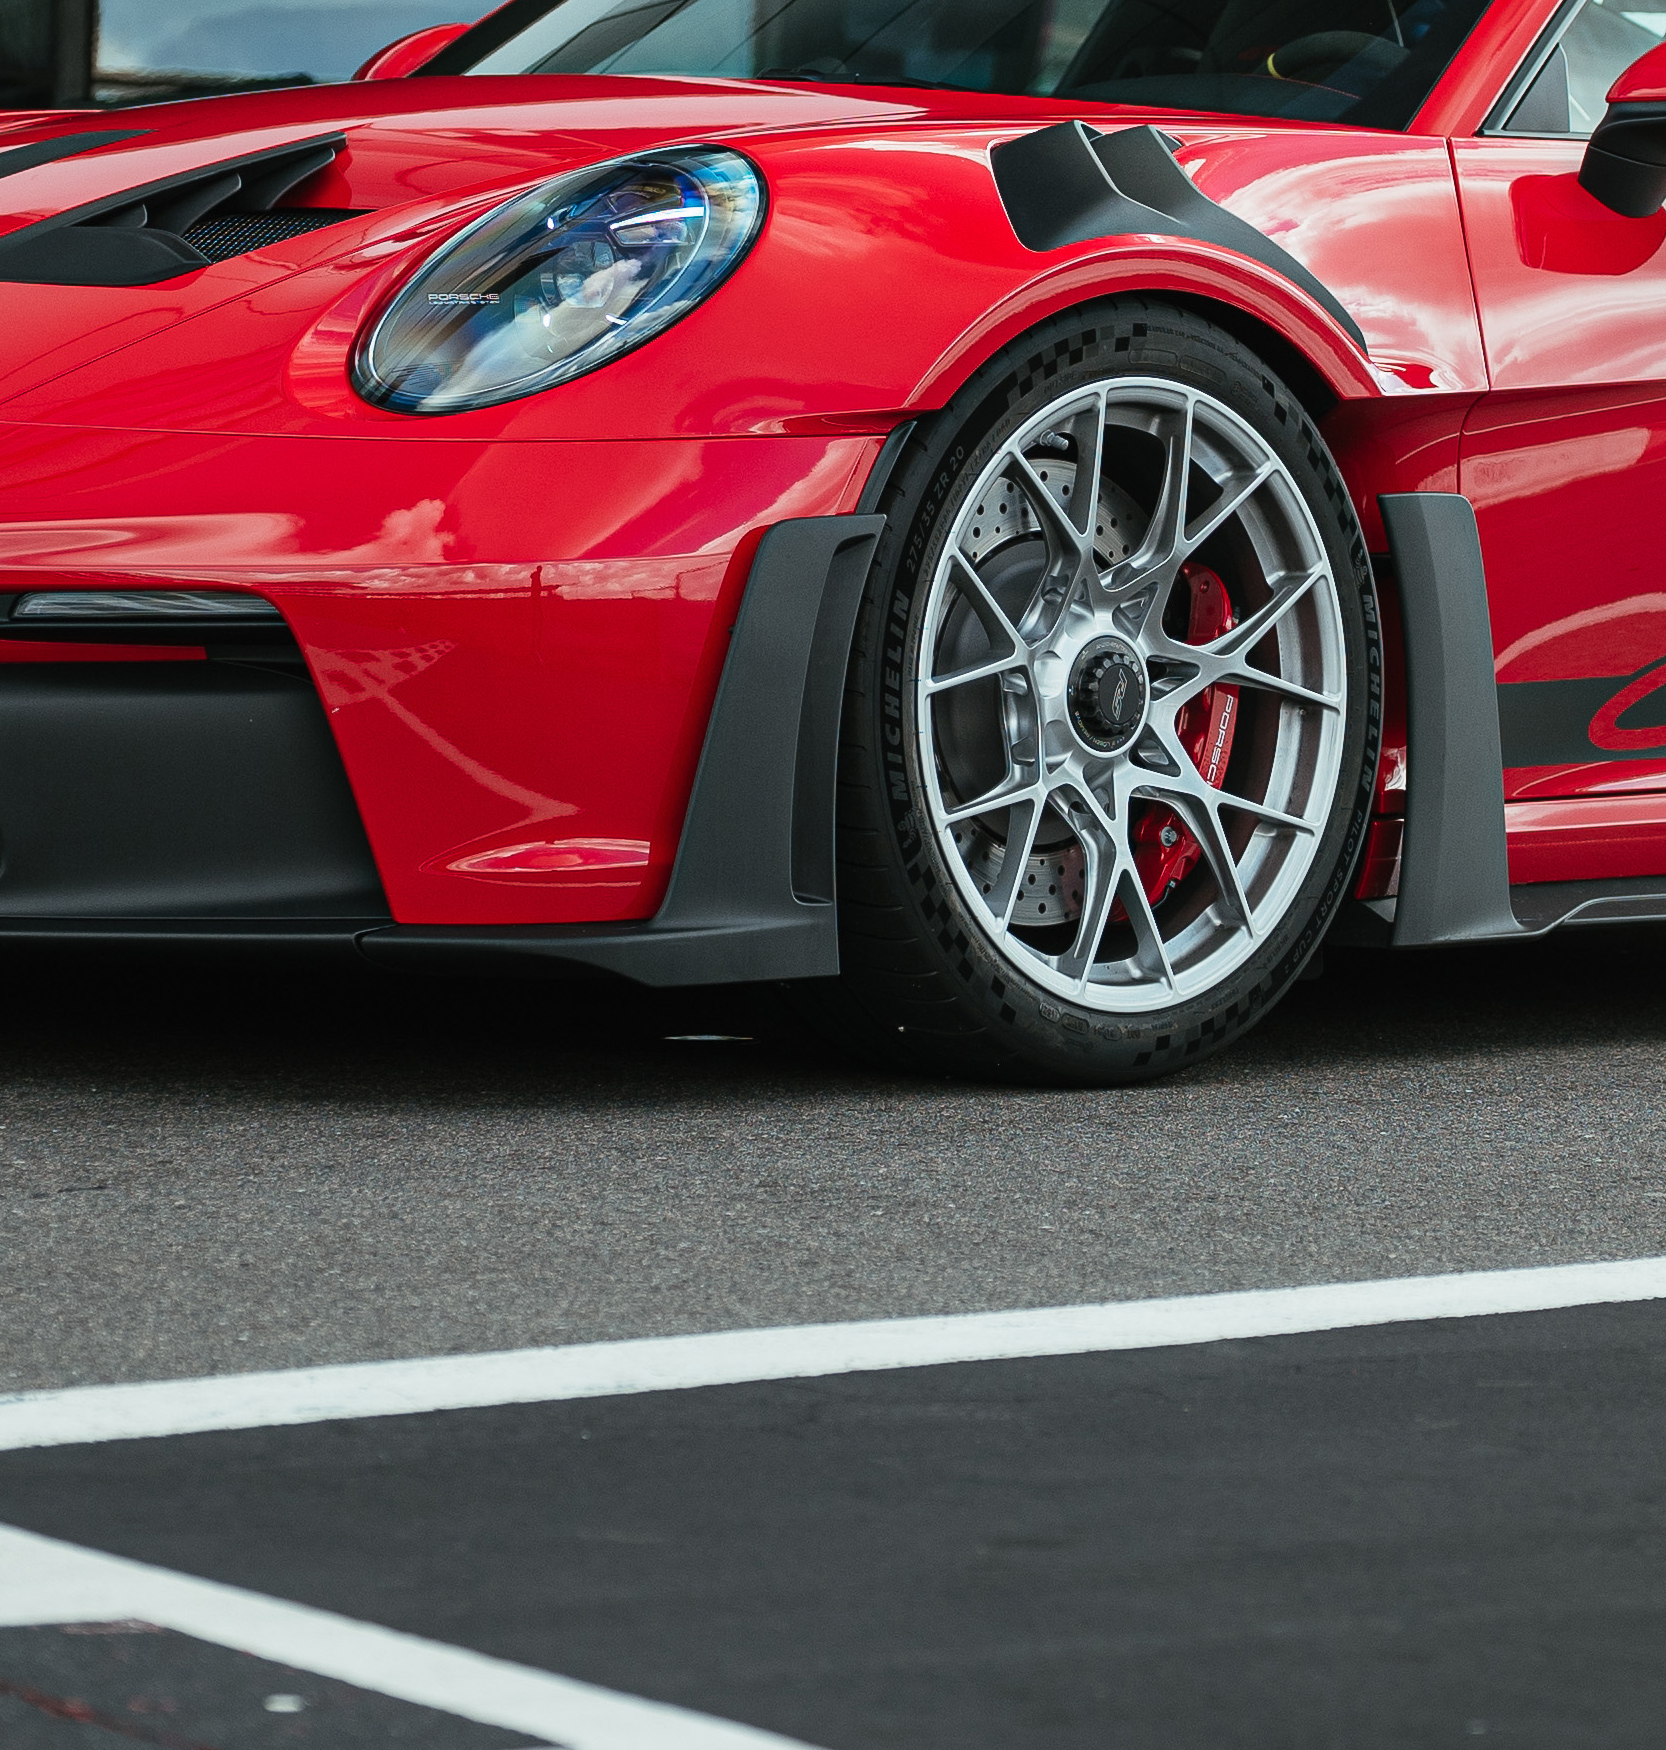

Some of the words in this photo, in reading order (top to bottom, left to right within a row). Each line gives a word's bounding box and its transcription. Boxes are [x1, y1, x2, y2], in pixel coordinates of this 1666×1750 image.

[428, 293, 500, 301] PORSCHE
[884, 589, 910, 802] MICHELIN
[906, 500, 935, 574] 275/35
[934, 471, 950, 500] ZR
[949, 445, 965, 472] 20
[1362, 593, 1381, 792] MICHELIN
[1206, 694, 1234, 785] PORSC
[1343, 808, 1363, 867] PILOT
[1315, 867, 1344, 925] SPORT
[1291, 929, 1313, 964] CUP
